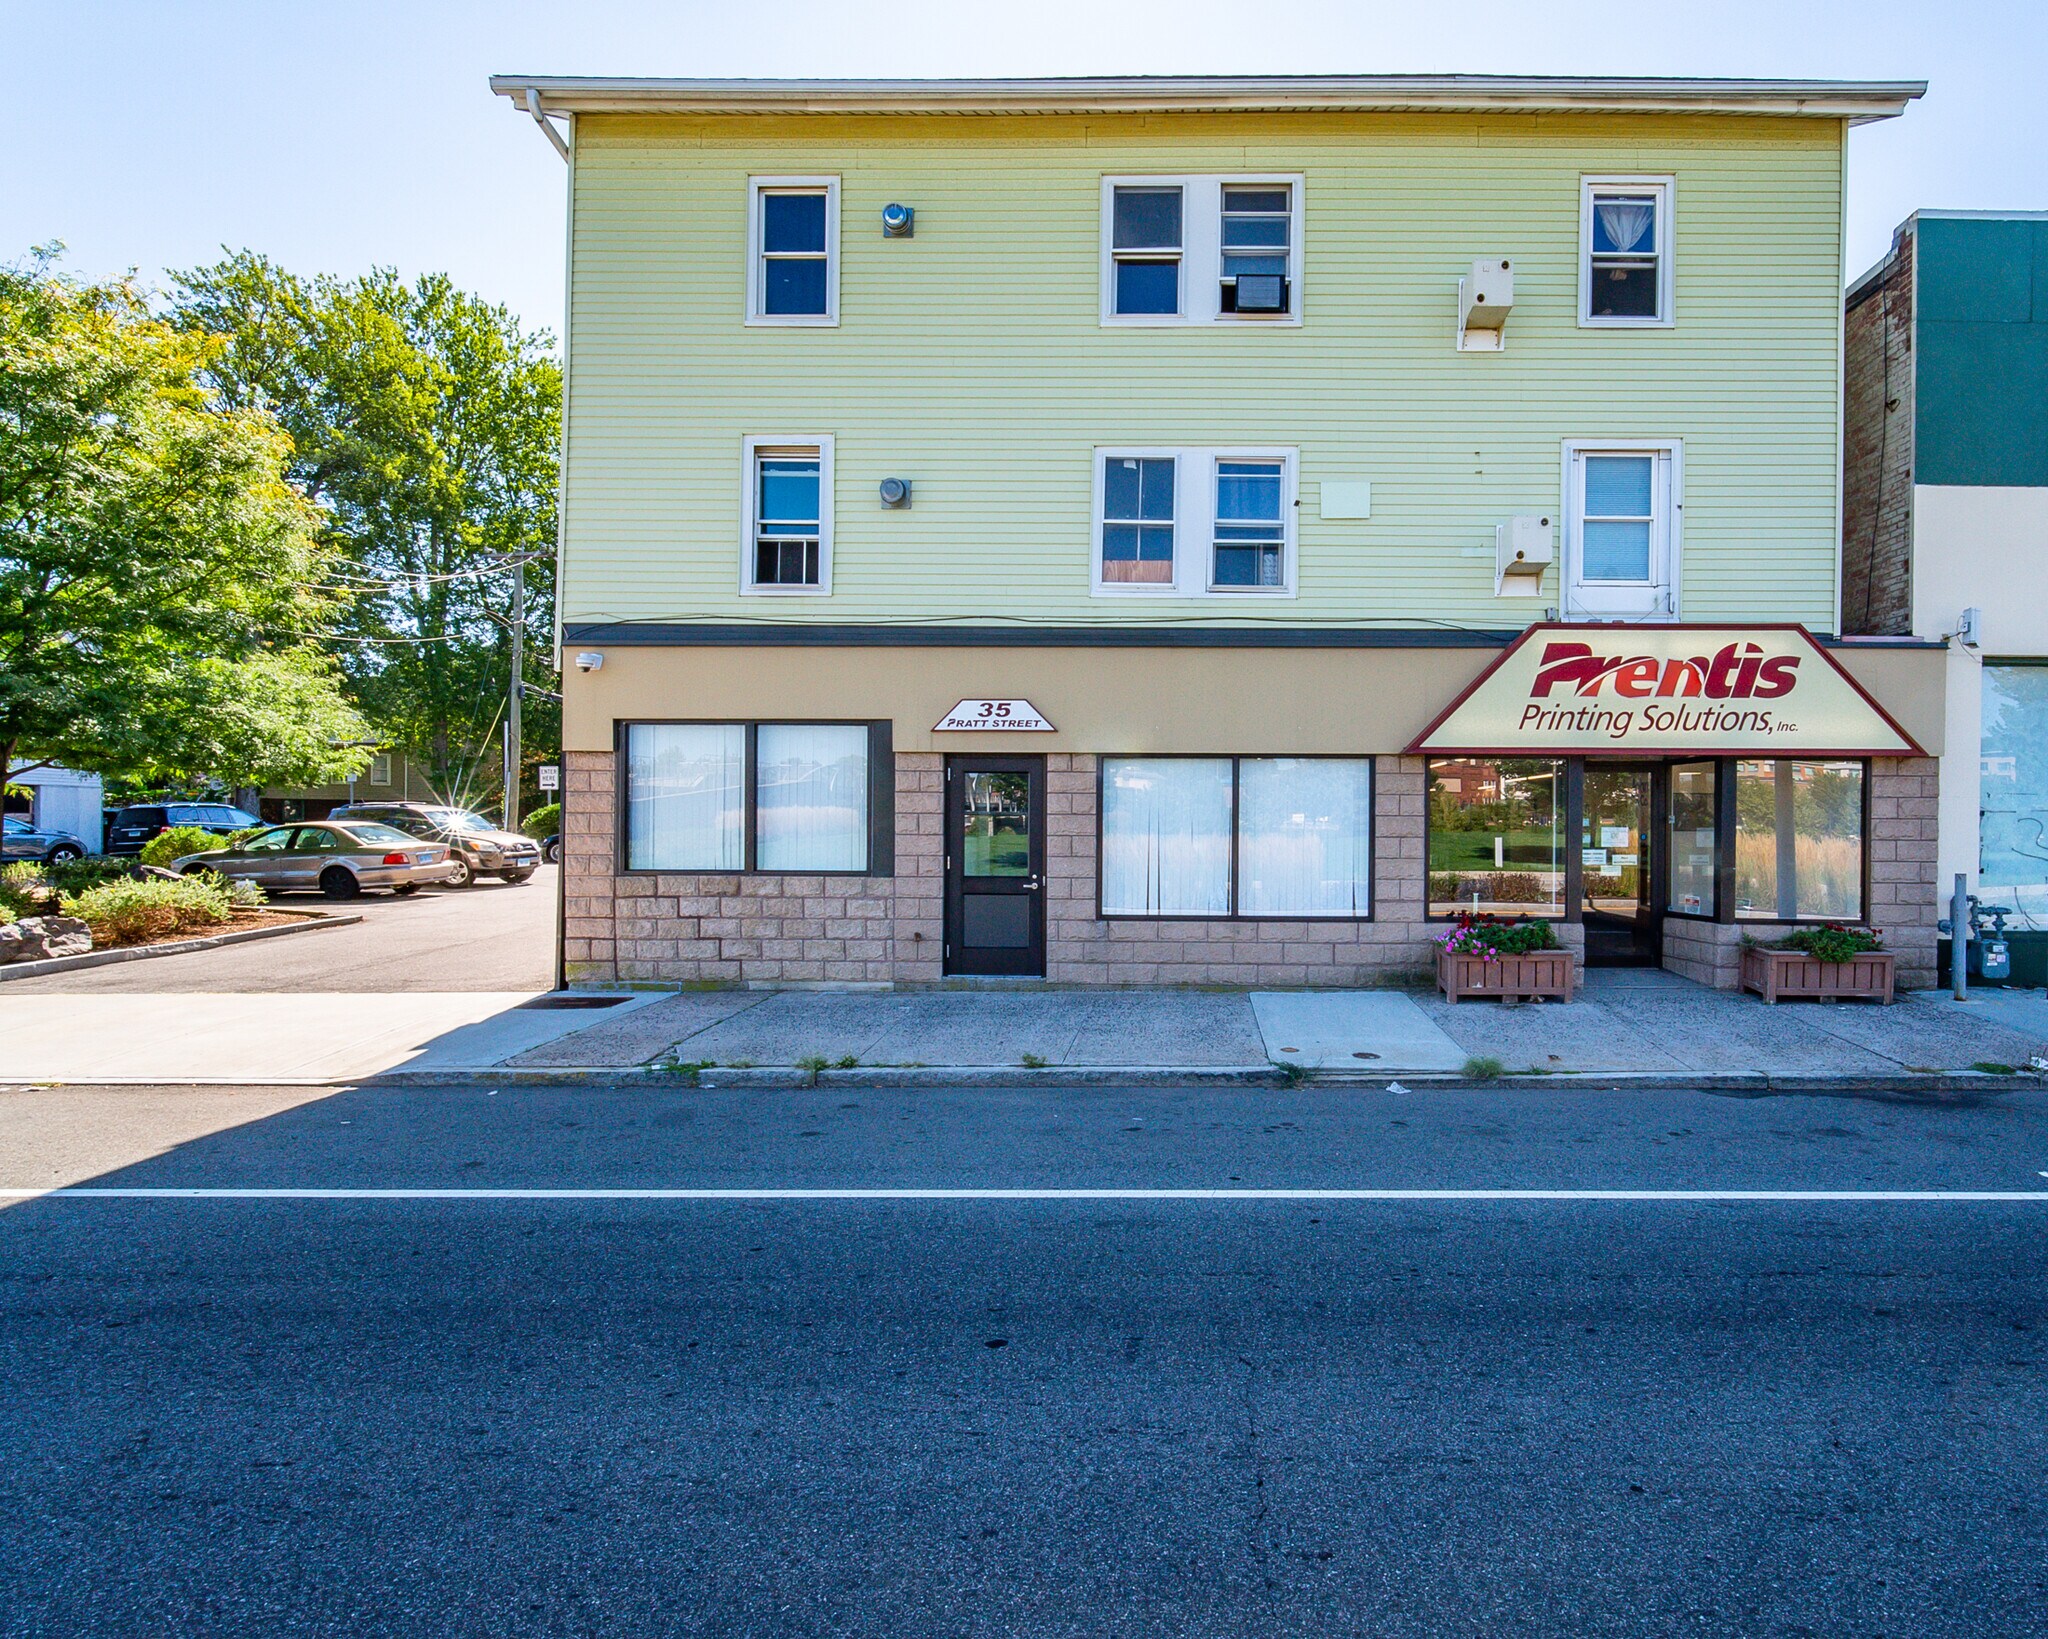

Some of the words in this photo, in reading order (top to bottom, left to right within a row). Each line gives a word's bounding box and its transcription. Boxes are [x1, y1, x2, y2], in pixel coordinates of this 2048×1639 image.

[1530, 642, 1801, 699] Prentis
[977, 703, 1011, 717] 35
[1518, 703, 1633, 738] Printing
[1638, 703, 1773, 735] Solutions,
[1776, 721, 1799, 732] Inc.
[947, 719, 988, 727] PRATT
